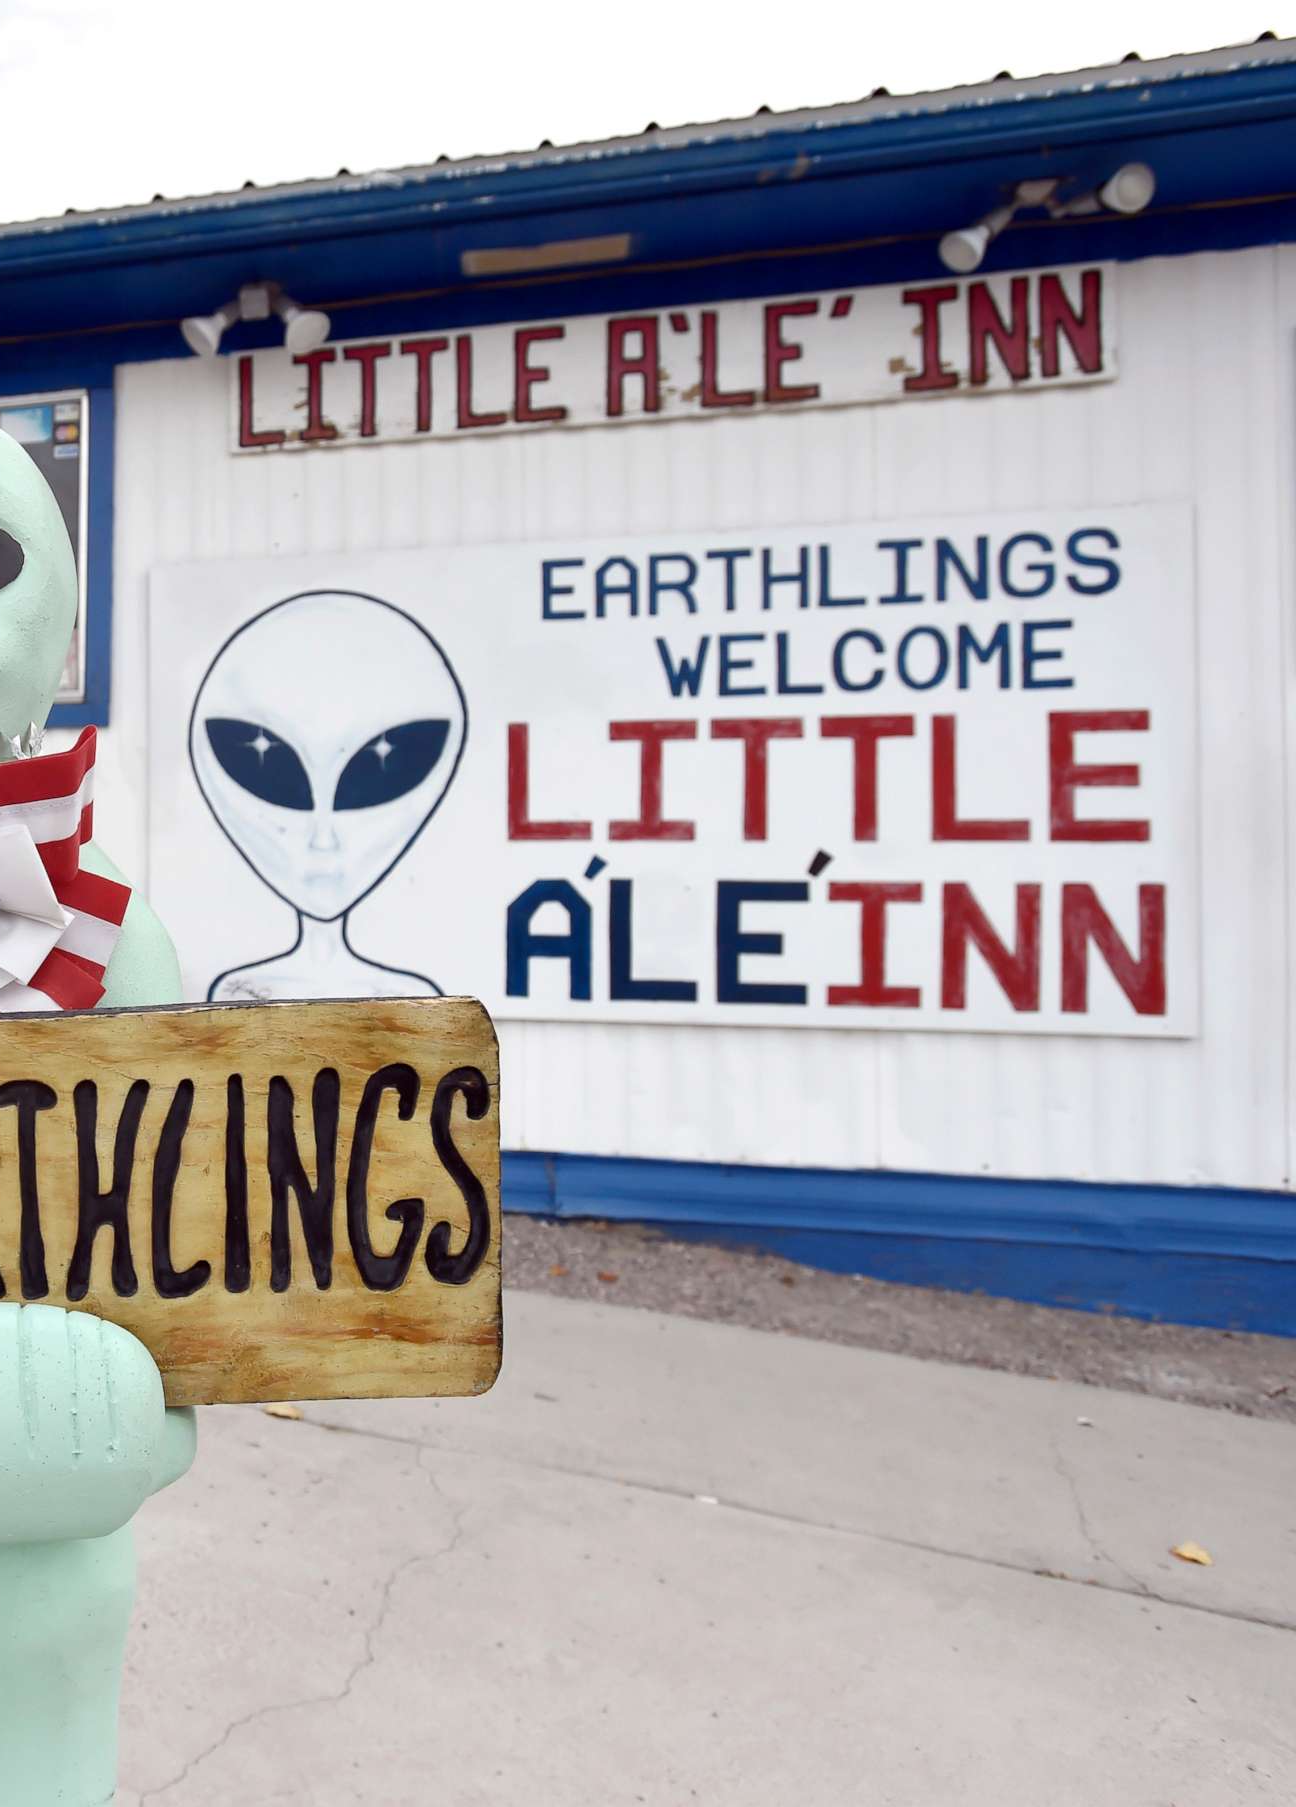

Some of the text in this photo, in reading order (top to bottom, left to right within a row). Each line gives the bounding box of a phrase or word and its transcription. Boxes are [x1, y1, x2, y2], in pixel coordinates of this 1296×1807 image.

[238, 325, 569, 448] LITTLE
[903, 269, 1103, 394] INN
[541, 527, 1122, 620] EARTHLINGS
[655, 619, 1075, 698] WELCOME
[507, 710, 1150, 842] LITTLE
